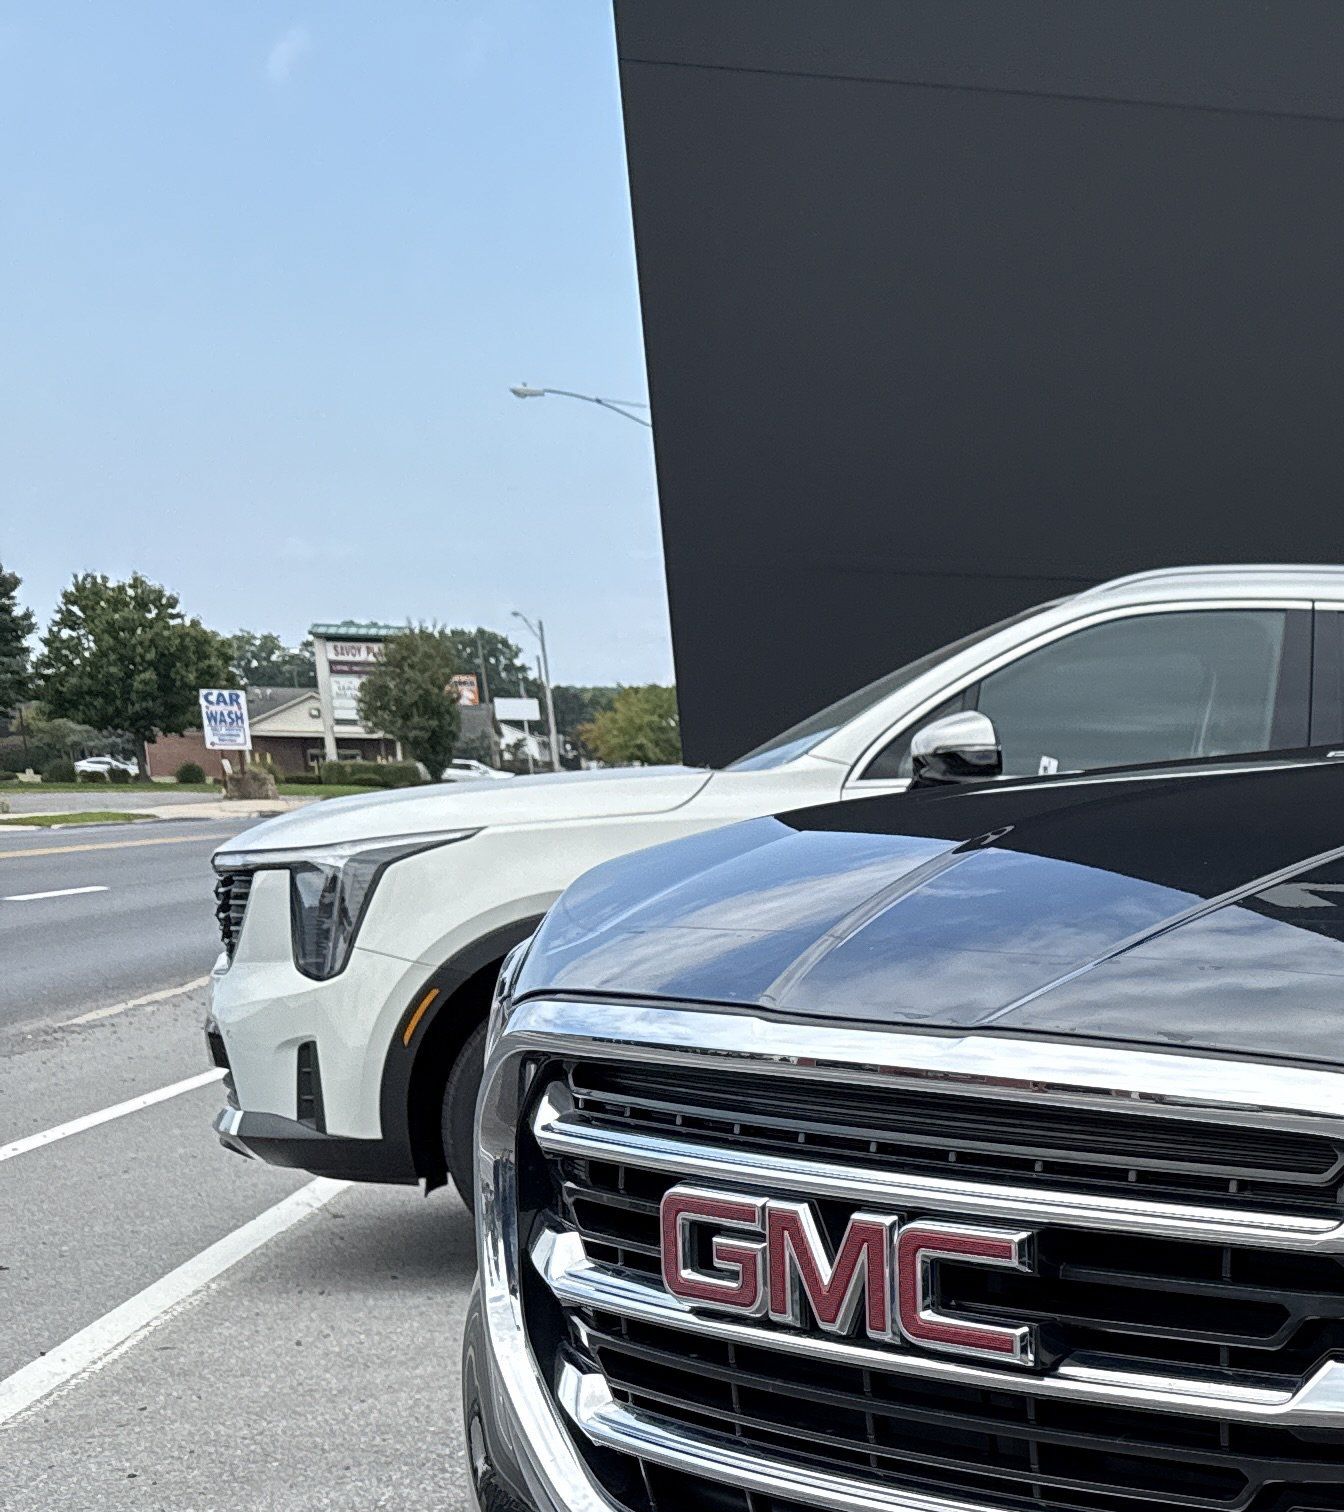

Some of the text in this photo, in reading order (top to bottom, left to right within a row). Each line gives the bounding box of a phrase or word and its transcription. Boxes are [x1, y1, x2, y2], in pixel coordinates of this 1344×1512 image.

[333, 644, 362, 657] SAVOY
[203, 691, 242, 710] CAR
[205, 710, 245, 726] WASH
[660, 1184, 1034, 1367] GMC
